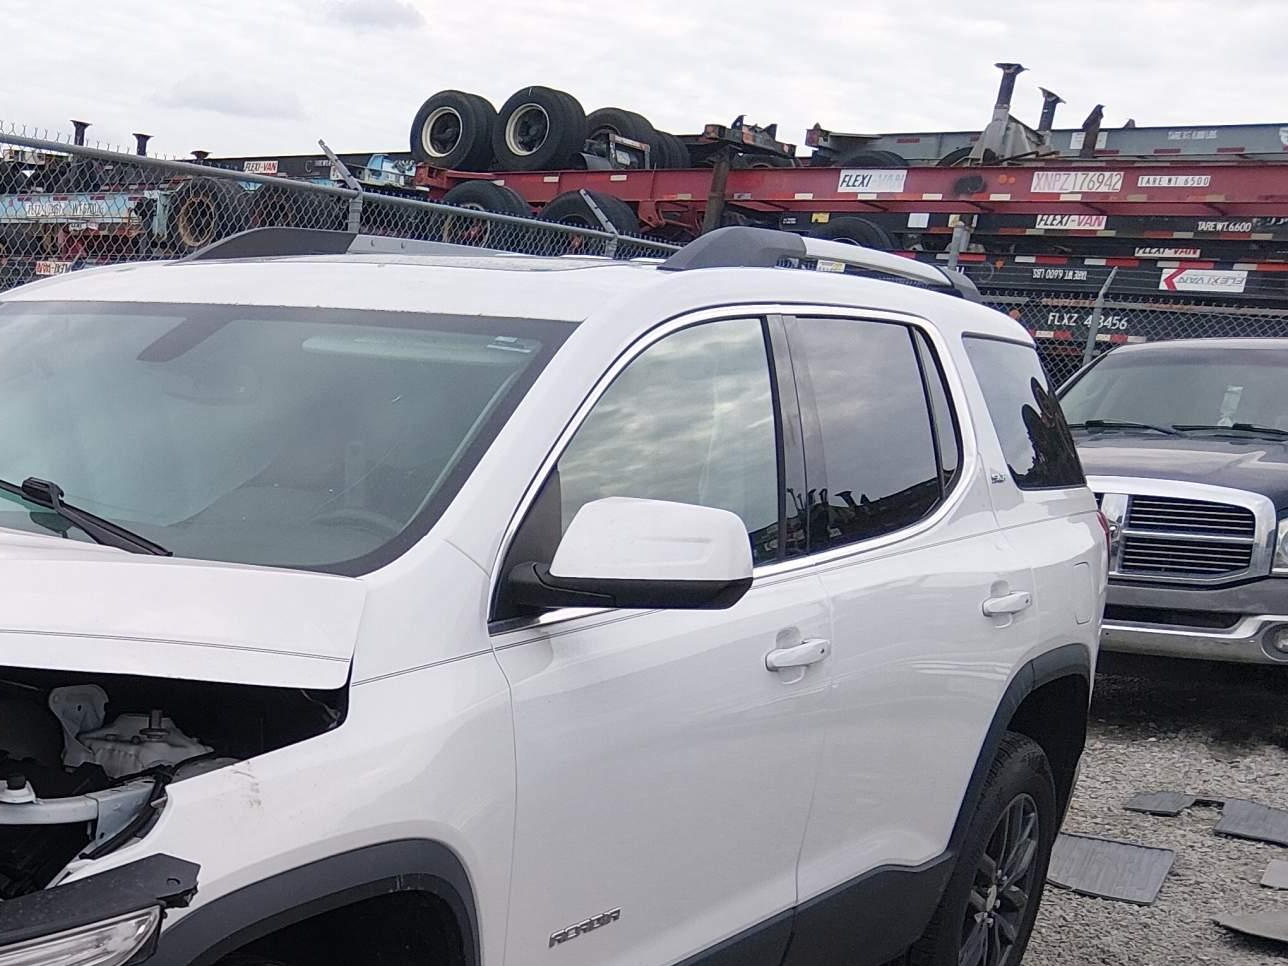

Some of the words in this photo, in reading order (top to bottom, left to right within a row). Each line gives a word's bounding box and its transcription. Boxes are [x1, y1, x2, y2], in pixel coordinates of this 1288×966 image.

[1033, 172, 1122, 191] XNPZ176942
[1140, 176, 1163, 186] TARE
[1183, 176, 1209, 186] 6500
[1037, 215, 1105, 227] FLEXI-VAN
[1197, 221, 1215, 231] TARE
[1047, 312, 1078, 326] FLXZ
[1083, 314, 1129, 330] 43456
[548, 906, 622, 948] ACADIA
